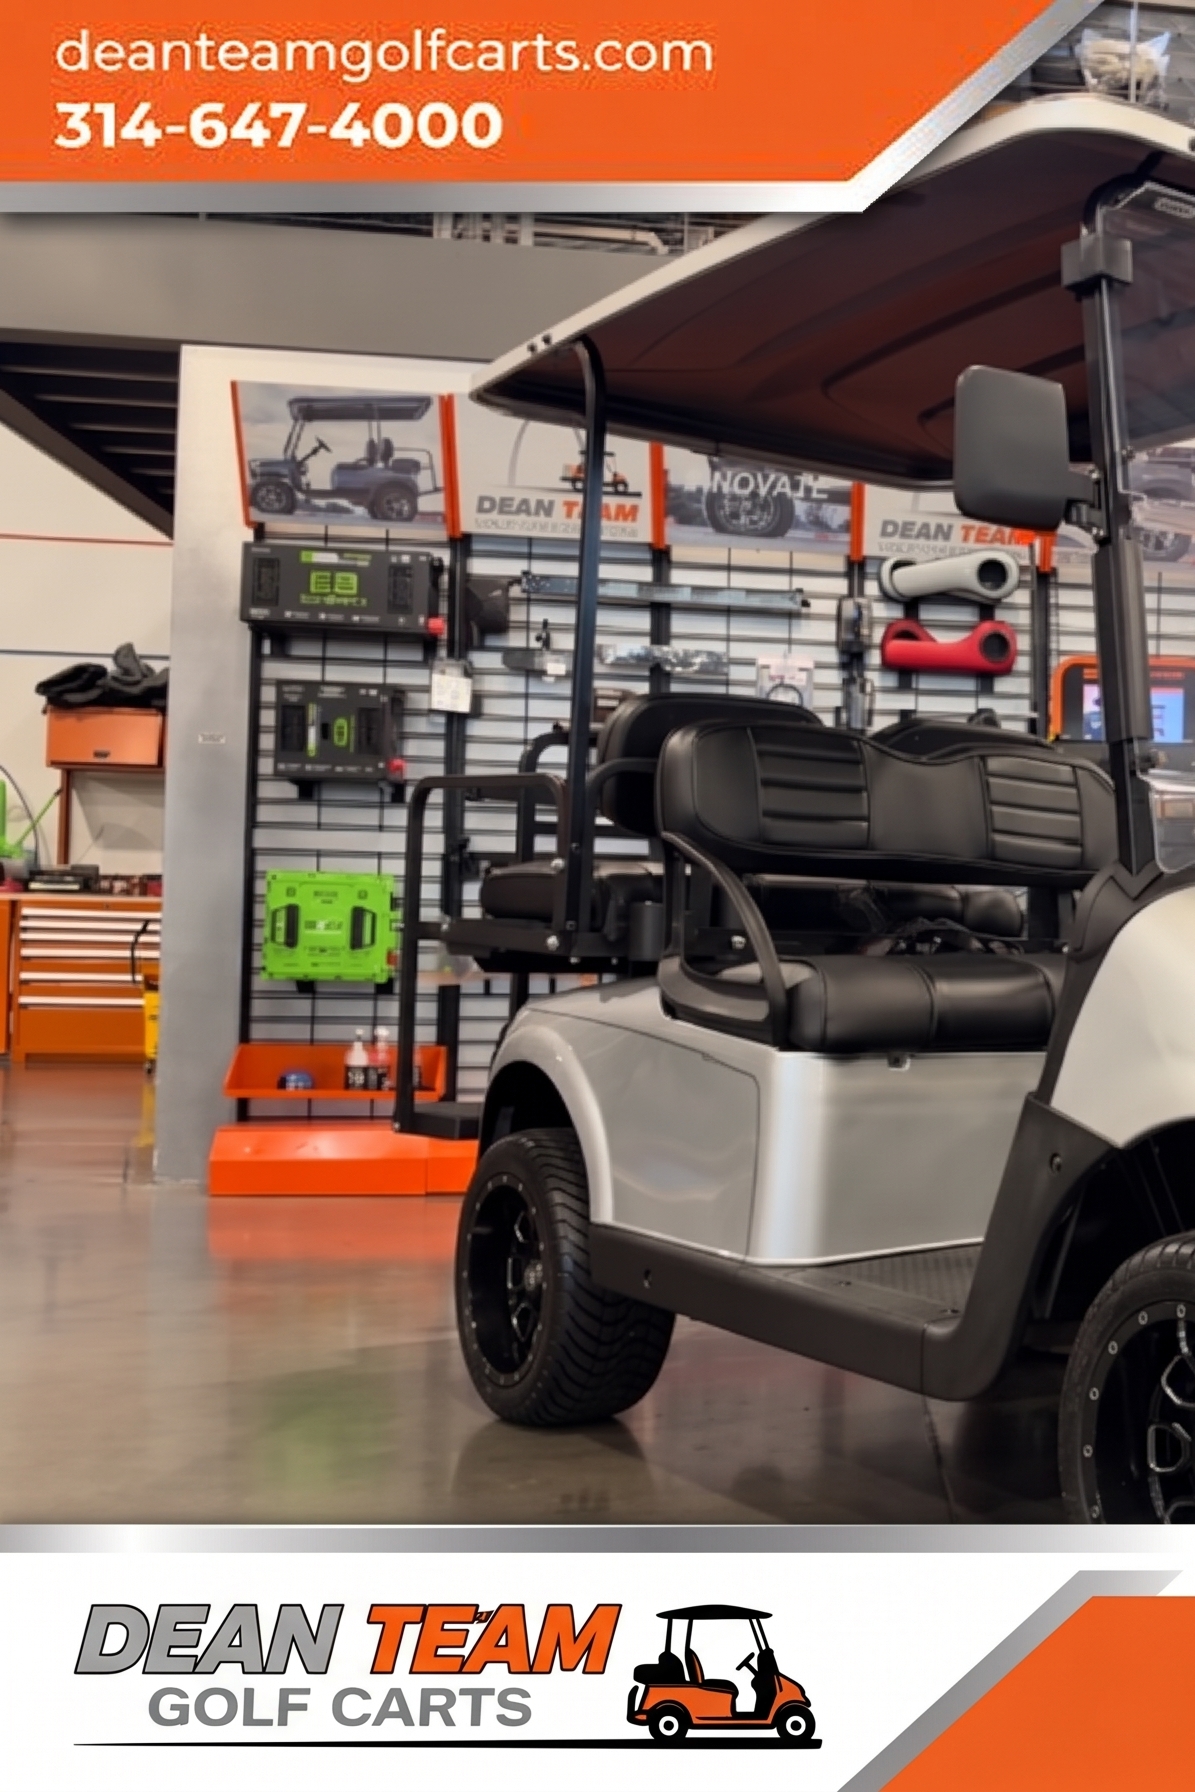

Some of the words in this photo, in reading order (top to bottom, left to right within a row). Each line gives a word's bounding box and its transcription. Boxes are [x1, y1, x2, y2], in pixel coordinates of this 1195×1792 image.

[475, 495, 556, 518] DEAN
[562, 500, 640, 523] TAM
[879, 519, 954, 542] DEAN
